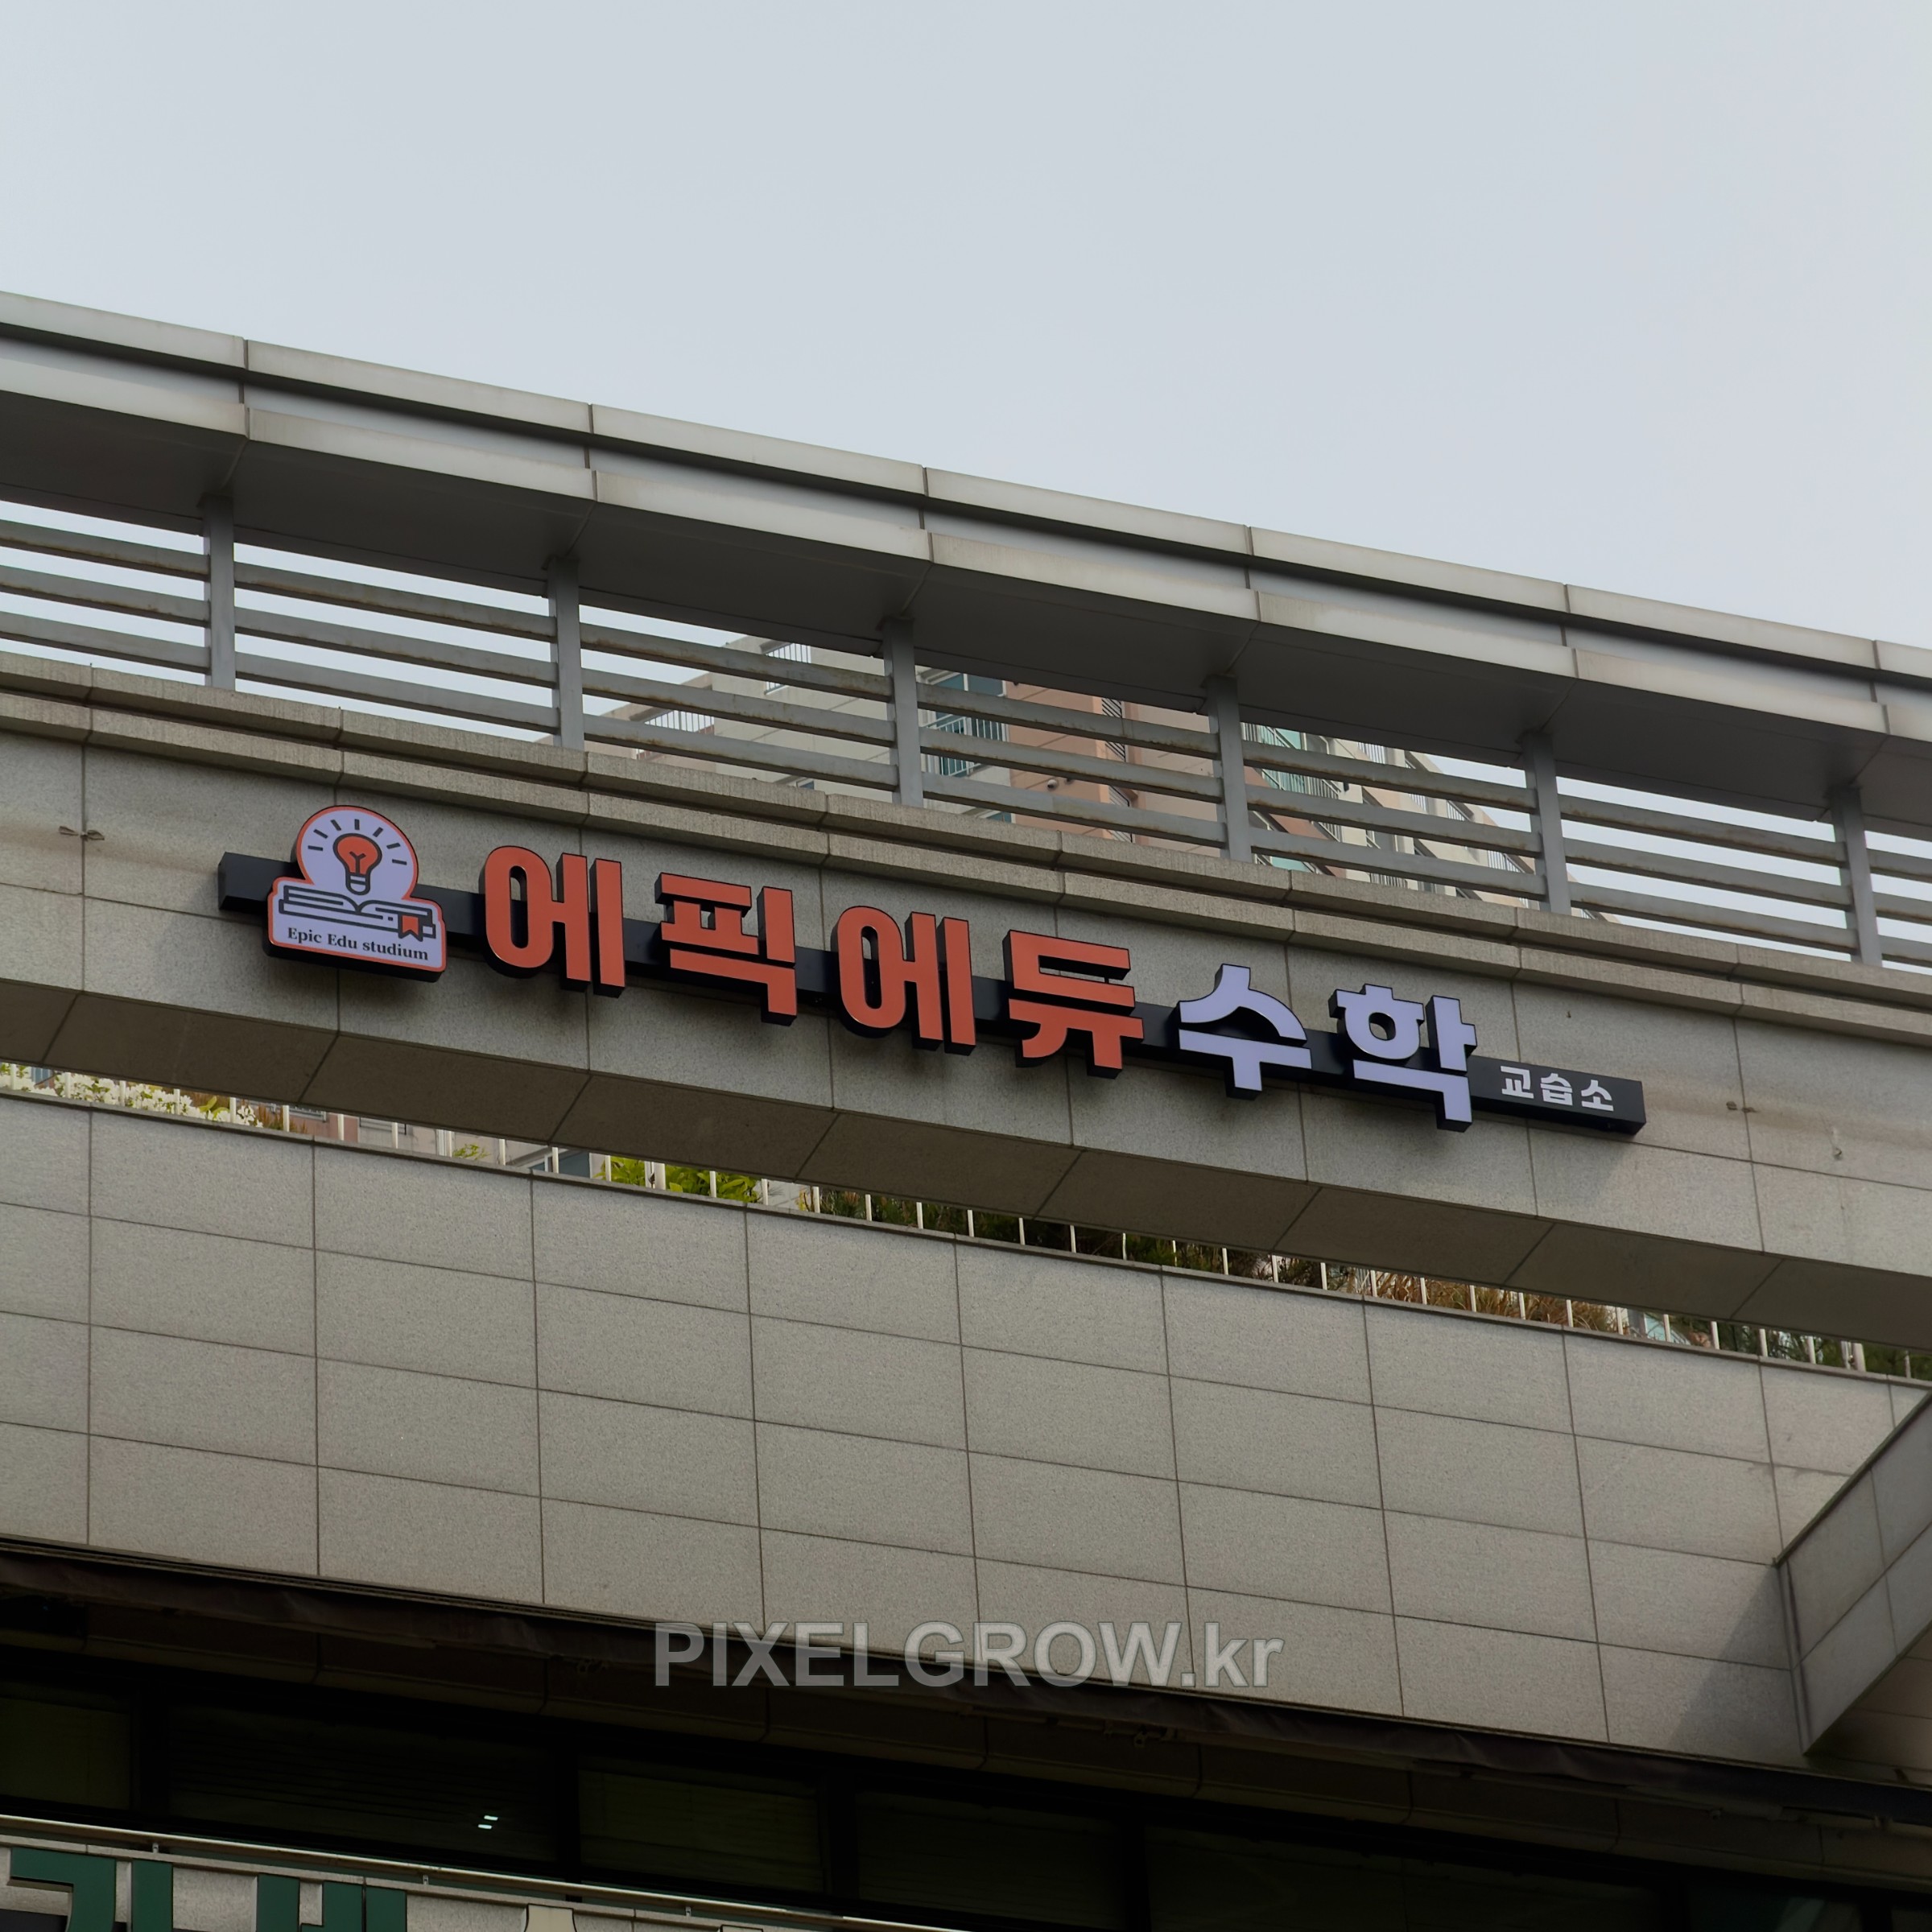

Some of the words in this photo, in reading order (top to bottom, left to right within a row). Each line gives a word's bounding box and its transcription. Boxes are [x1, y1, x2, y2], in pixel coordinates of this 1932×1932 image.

[287, 927, 322, 944] Epic
[327, 933, 357, 949] Edu
[362, 940, 429, 960] studium
[1500, 1065, 1615, 1112] 교습소
